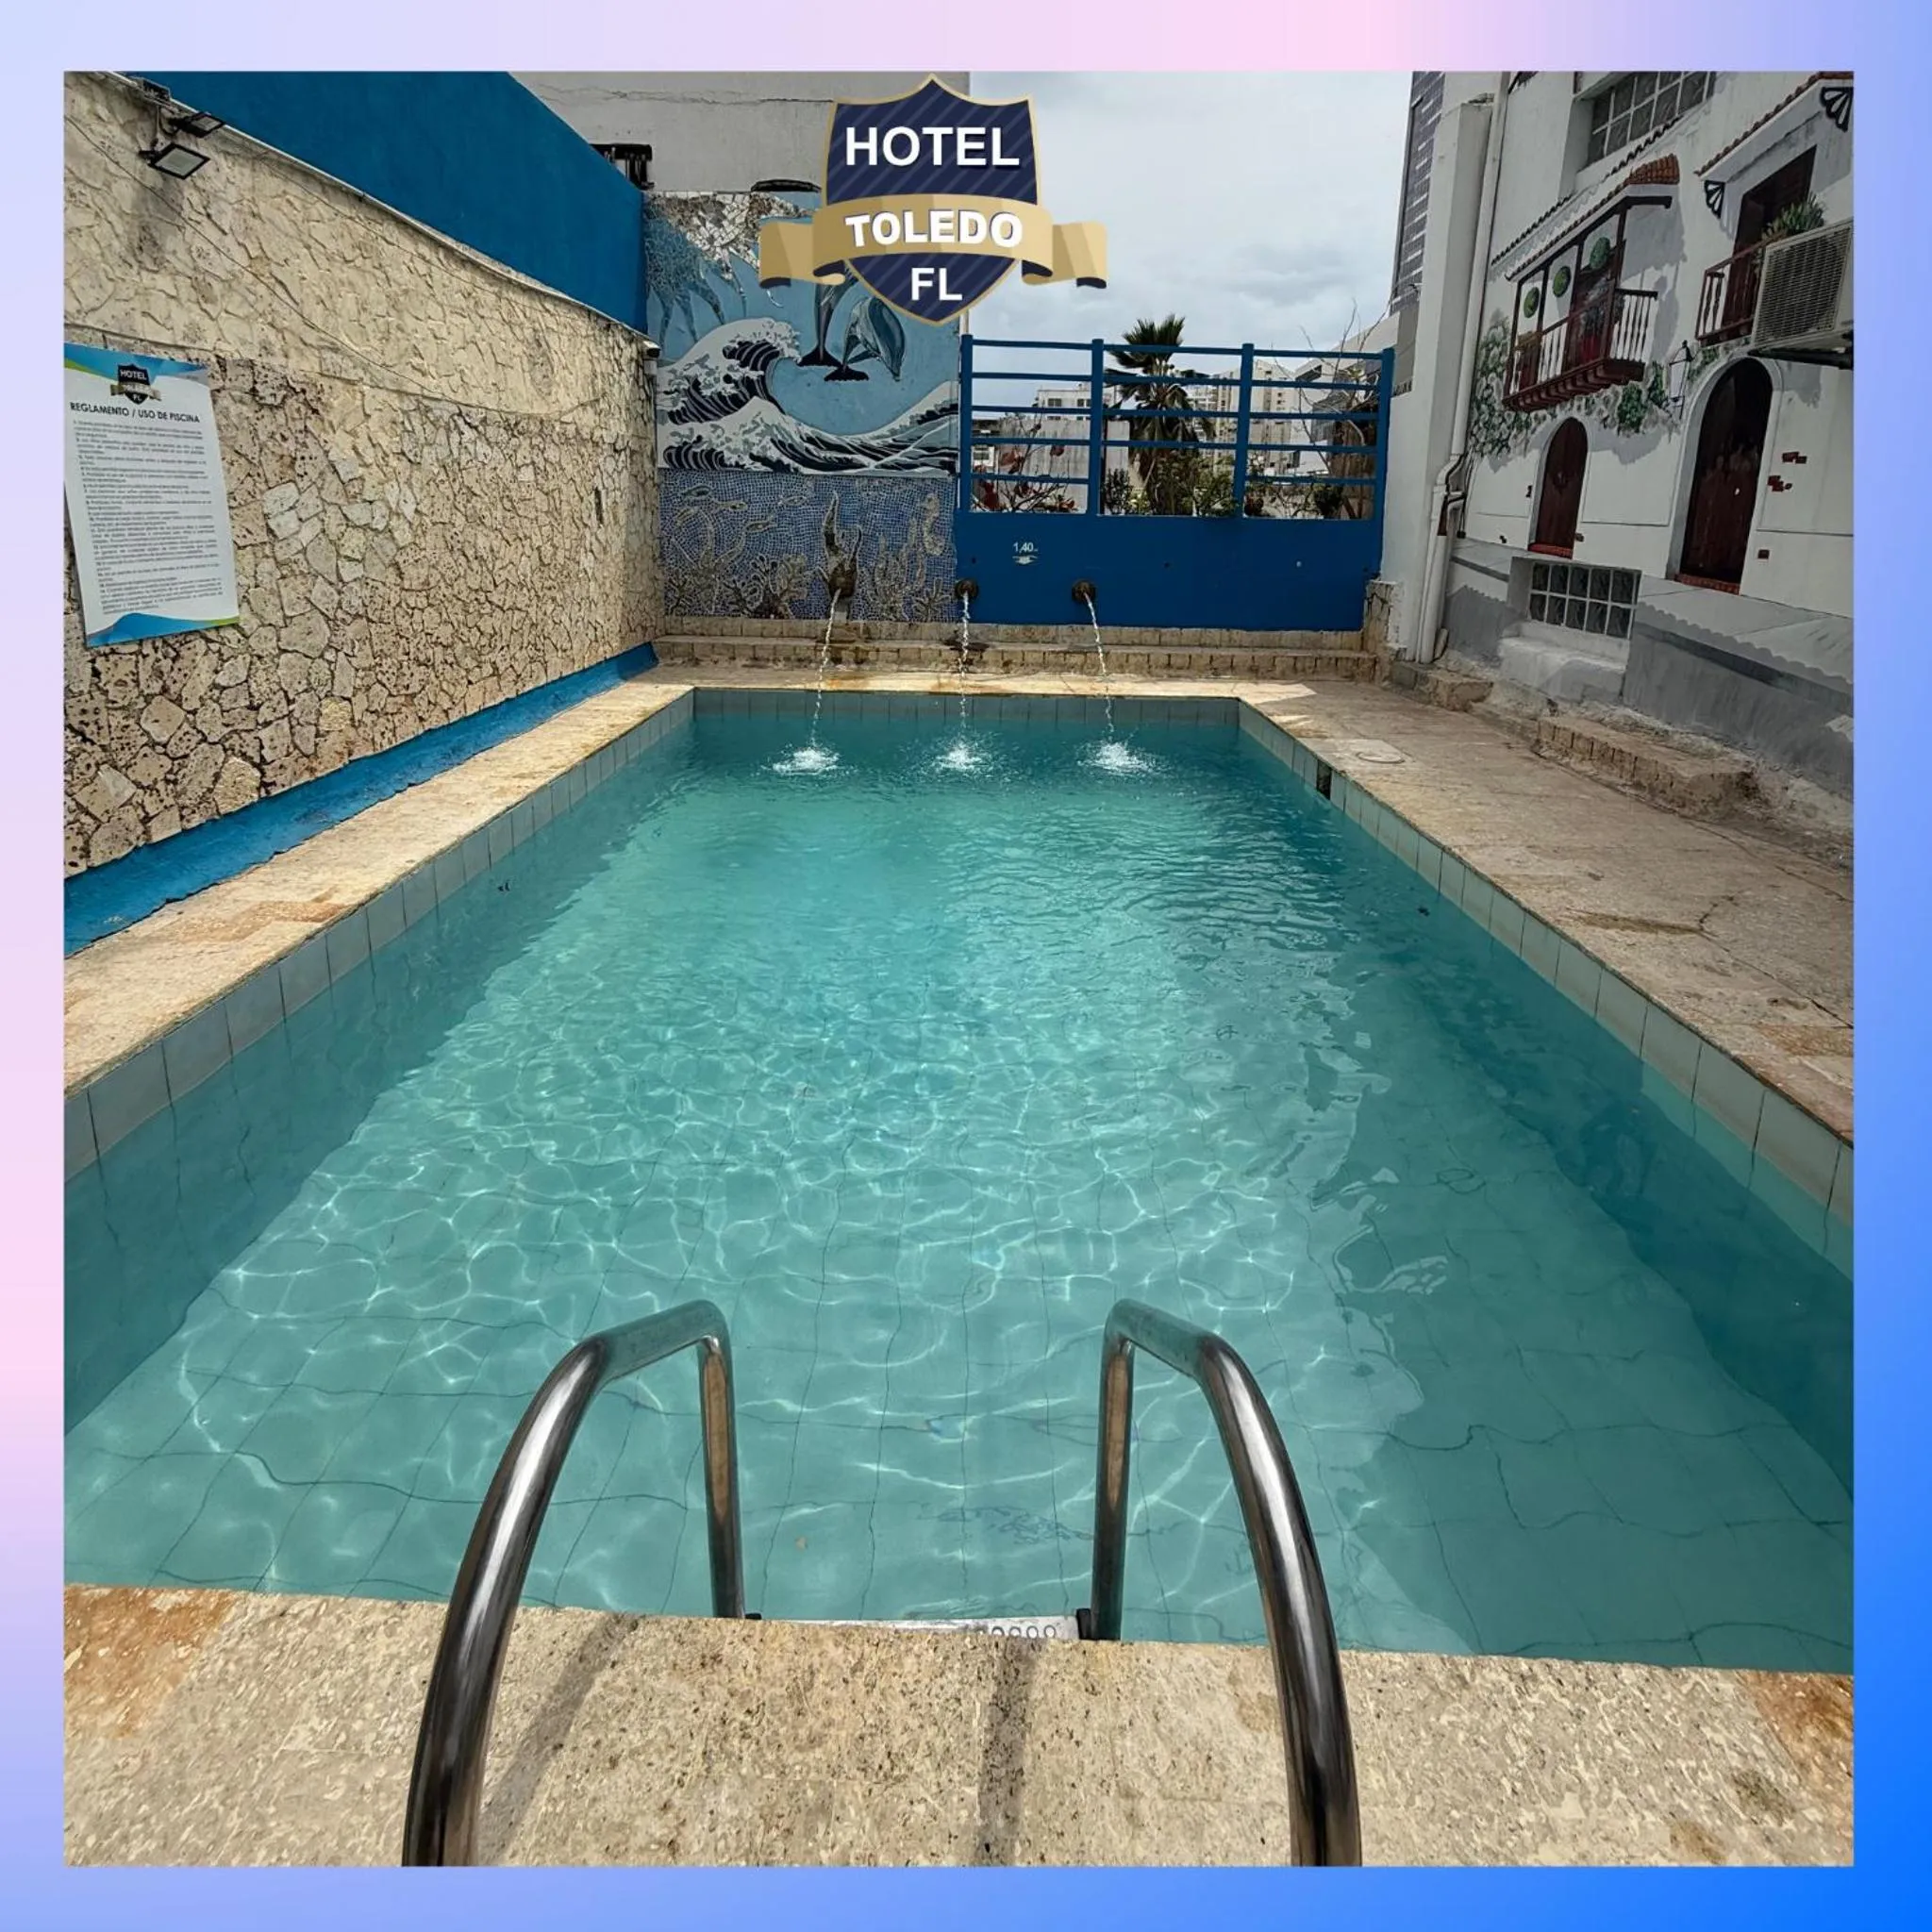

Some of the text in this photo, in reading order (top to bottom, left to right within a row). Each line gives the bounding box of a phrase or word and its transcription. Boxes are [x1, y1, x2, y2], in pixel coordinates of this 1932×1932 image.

[120, 369, 147, 380] HOTEL
[70, 402, 129, 416] REGLAMENTO
[138, 409, 156, 419] USO
[158, 411, 168, 421] DE
[170, 412, 200, 423] PISCINA
